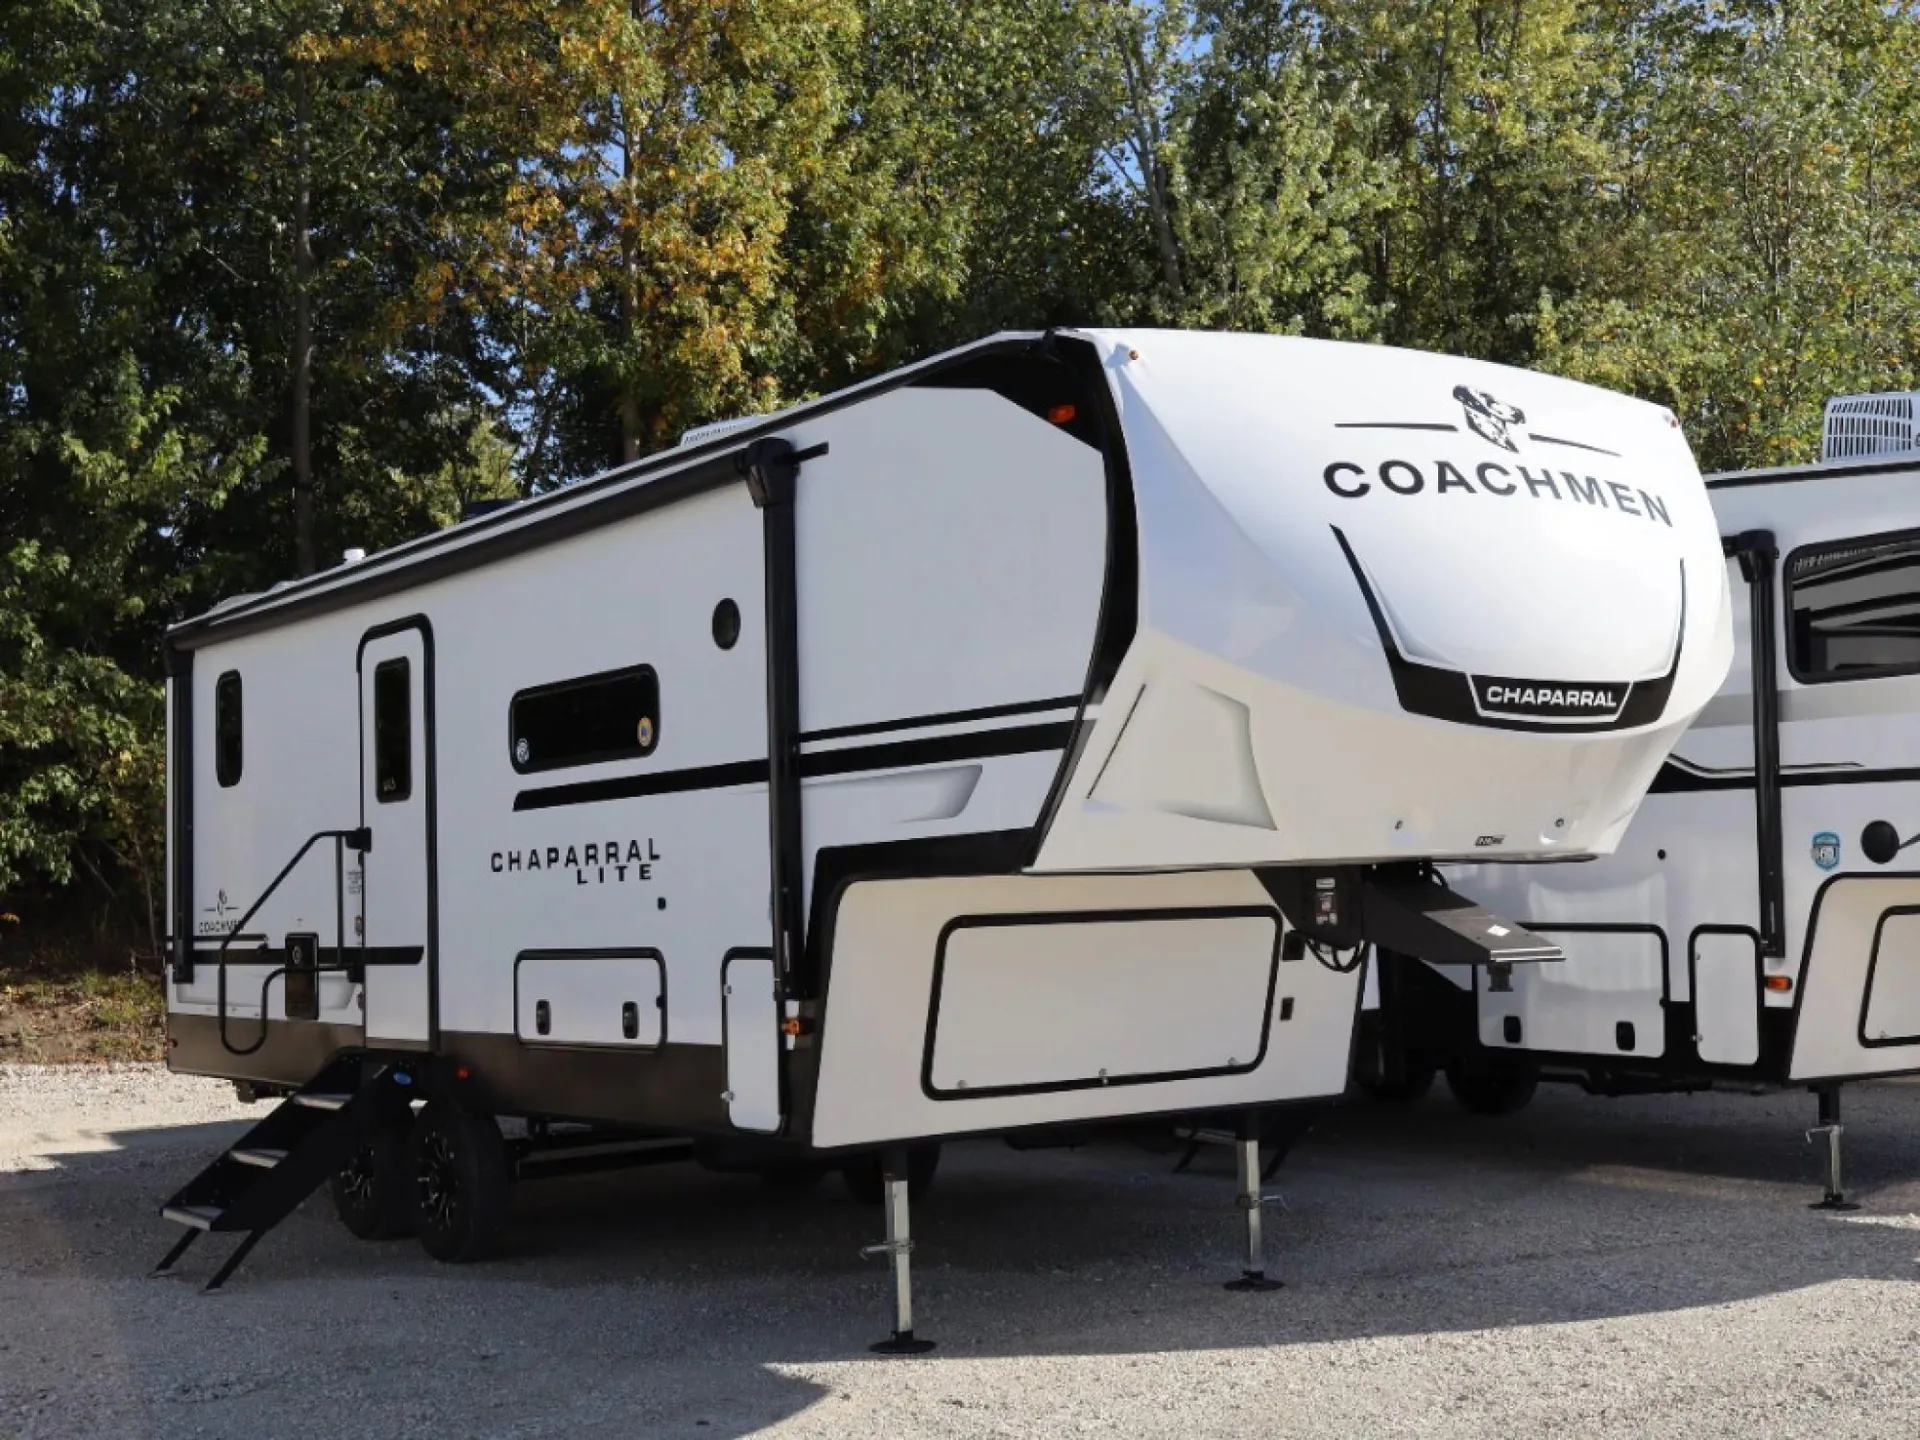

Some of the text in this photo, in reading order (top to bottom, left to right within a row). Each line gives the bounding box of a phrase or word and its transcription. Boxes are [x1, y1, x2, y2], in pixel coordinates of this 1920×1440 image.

[1323, 459, 1673, 528] COACHMEN
[1486, 685, 1617, 708] CHAPARRAL
[491, 837, 661, 873] CHAPARRAL
[576, 863, 653, 885] LITE
[199, 919, 245, 933] COACHM
